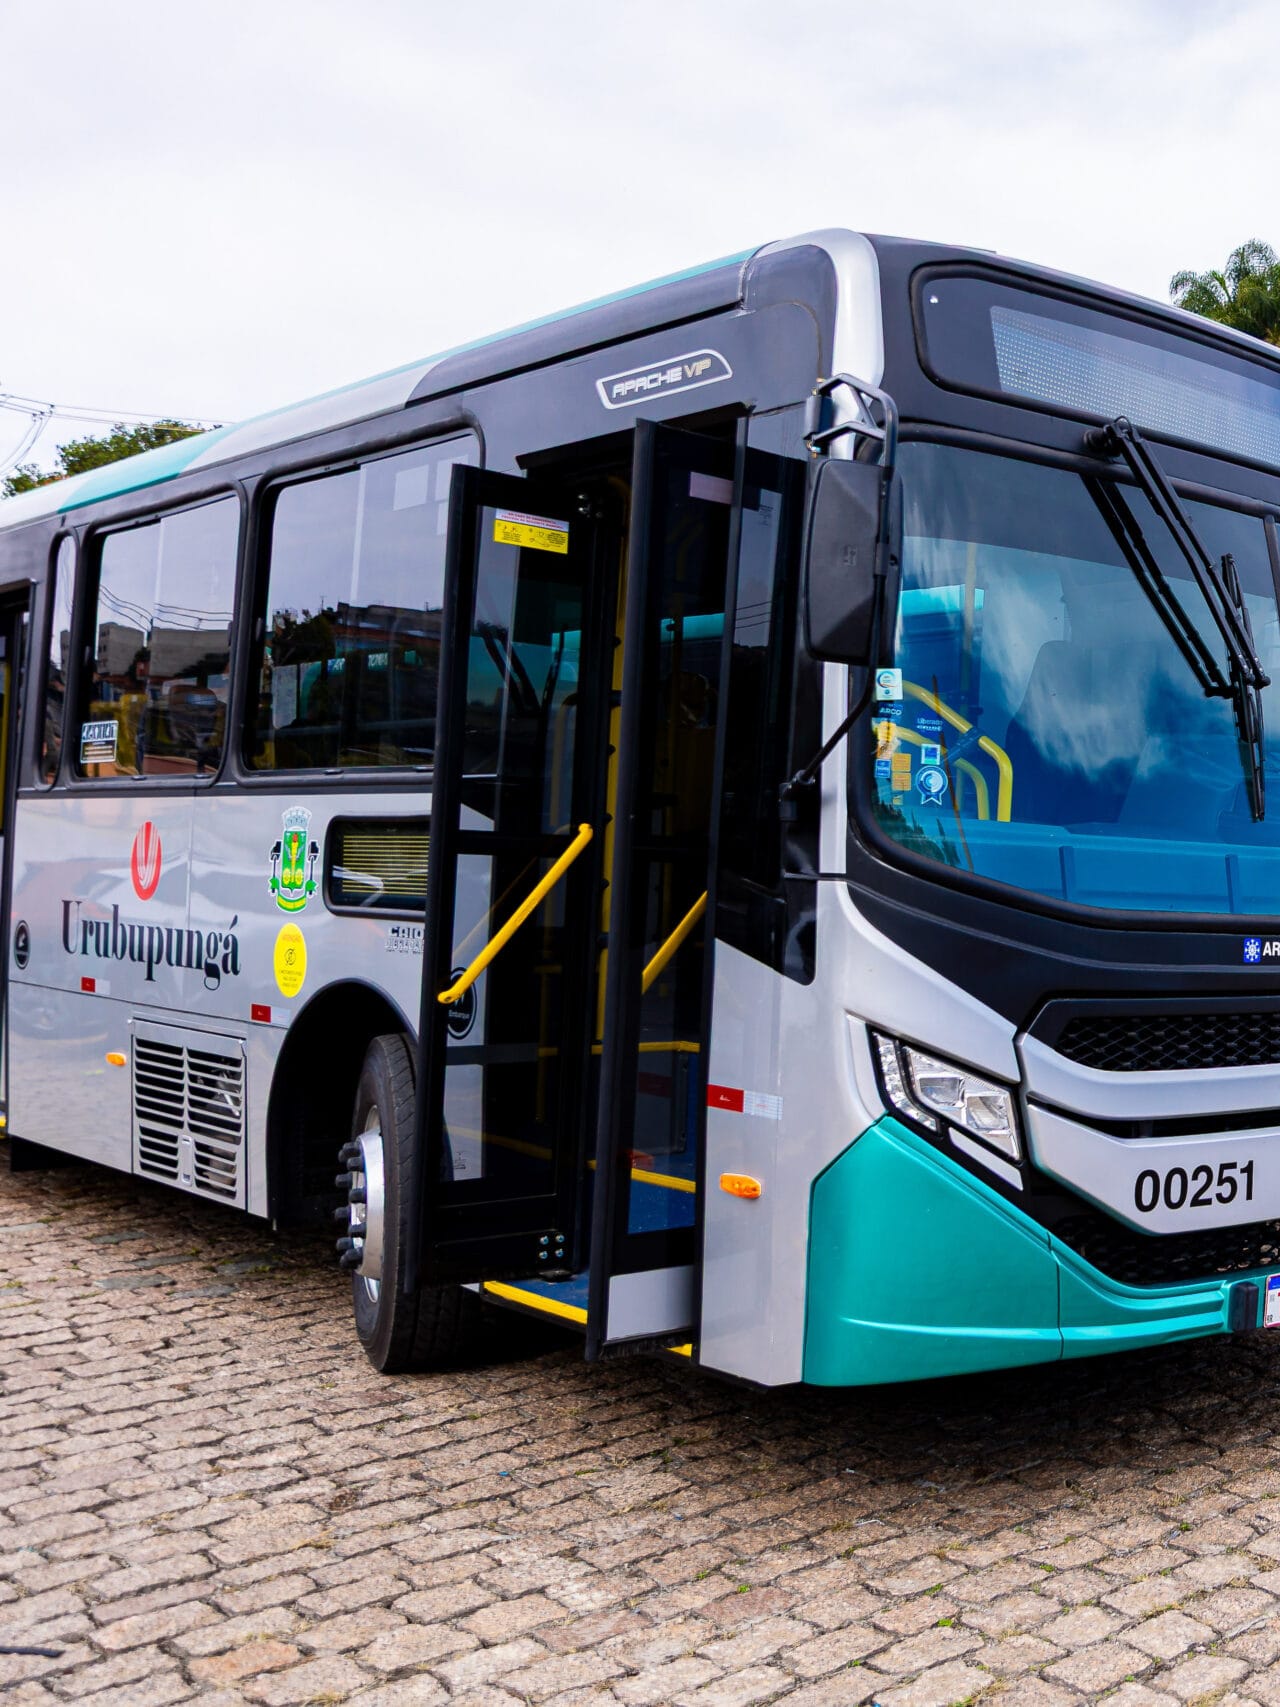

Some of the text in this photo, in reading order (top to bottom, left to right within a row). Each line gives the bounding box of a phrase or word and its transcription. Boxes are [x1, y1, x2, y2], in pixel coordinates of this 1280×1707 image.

[612, 358, 712, 399] APACHE VIP
[61, 899, 242, 991] Urubupungá
[389, 926, 424, 939] CAIO
[1134, 1159, 1255, 1213] 00251
